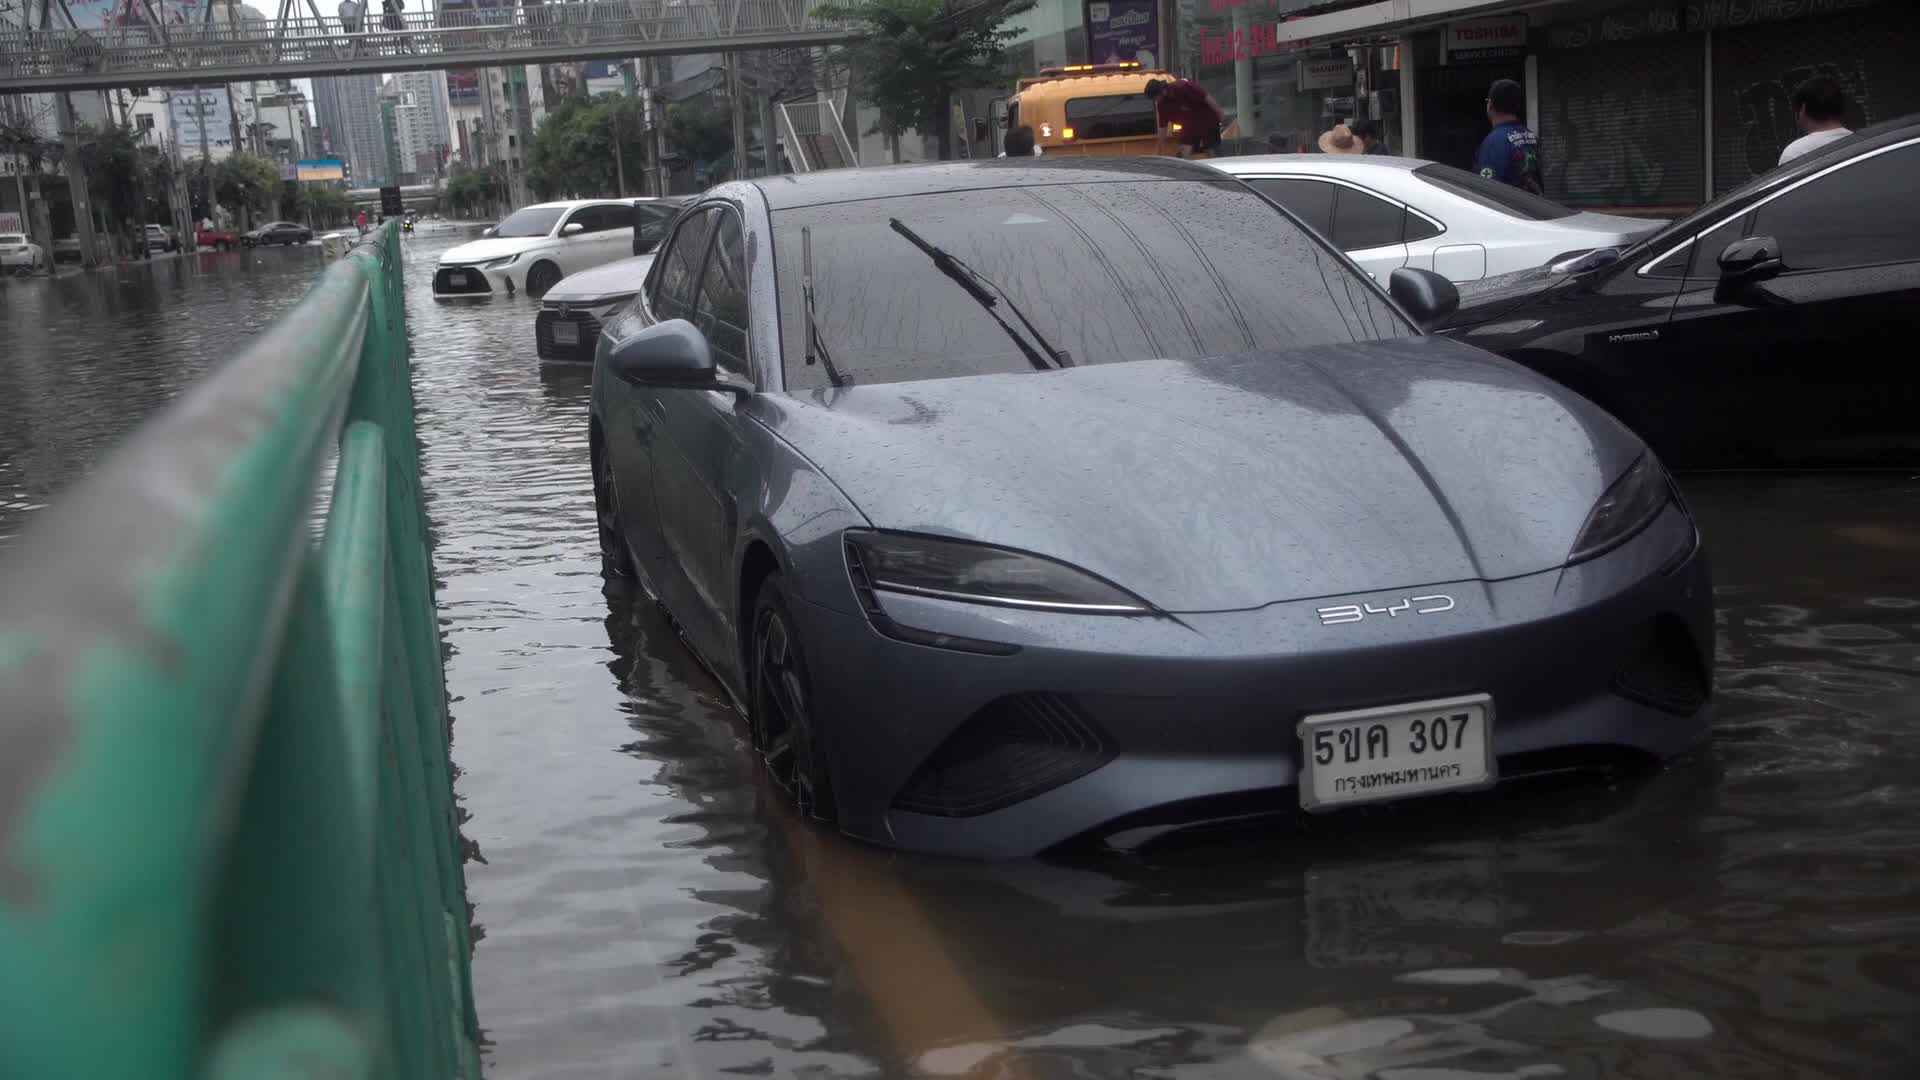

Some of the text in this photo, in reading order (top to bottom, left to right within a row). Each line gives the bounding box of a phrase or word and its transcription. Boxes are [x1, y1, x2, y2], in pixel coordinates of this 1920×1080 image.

[1456, 24, 1521, 41] TOSHIBA
[1608, 332, 1650, 344] HYBRID
[1317, 594, 1455, 625] BYD
[1314, 713, 1470, 766] 5ขค 307
[1335, 761, 1461, 794] กรุงเทพมหานคร
